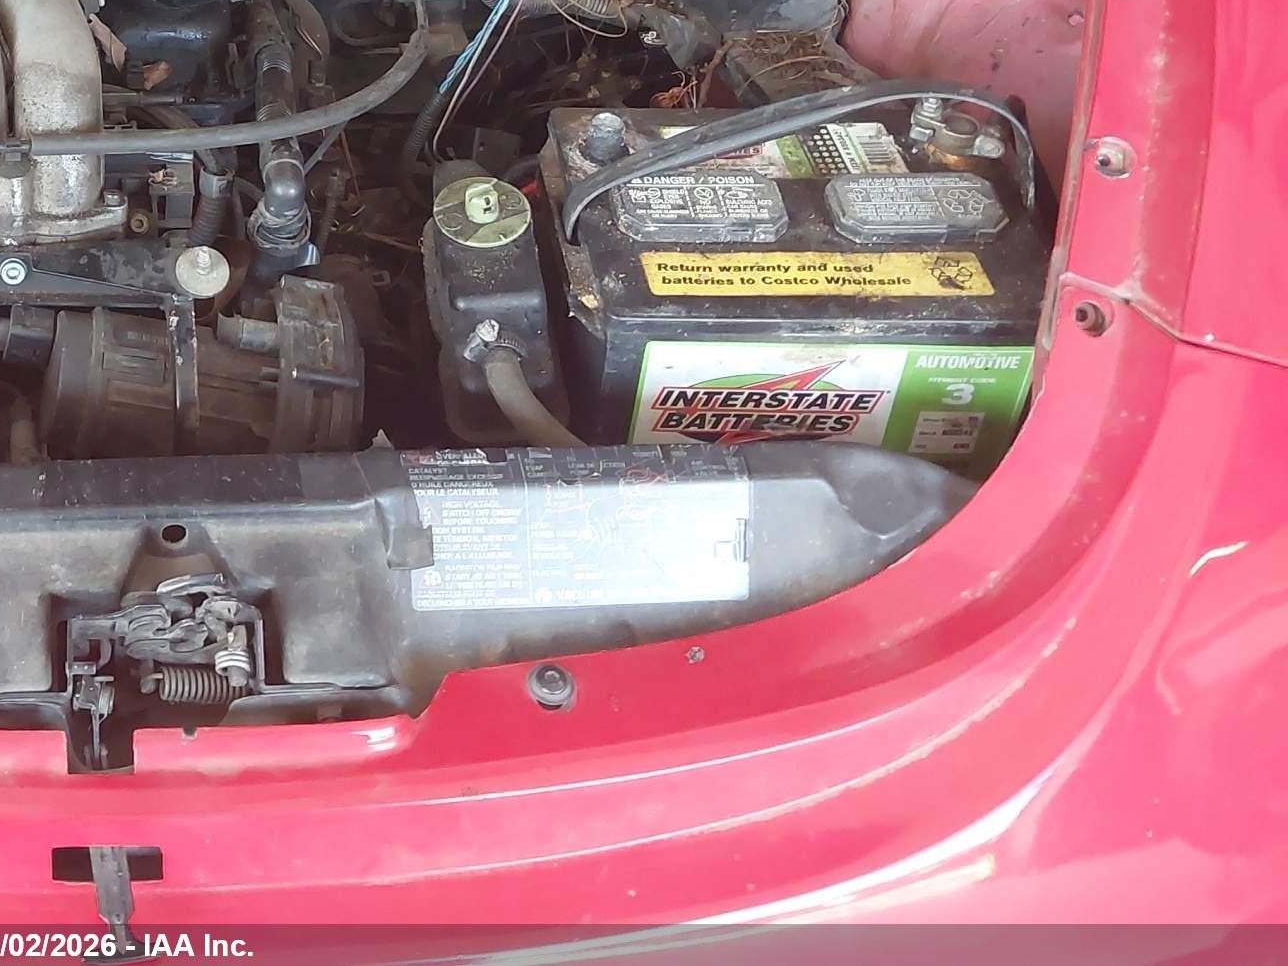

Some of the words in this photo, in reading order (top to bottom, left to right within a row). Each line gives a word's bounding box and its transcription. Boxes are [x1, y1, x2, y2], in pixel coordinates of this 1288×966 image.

[657, 262, 712, 273] Return
[718, 263, 791, 274] warranty
[797, 262, 828, 273] and
[833, 263, 874, 274] used
[661, 275, 735, 286] batteries
[740, 276, 757, 286] to
[761, 276, 819, 286] Costco
[824, 276, 912, 286] Wholesale
[915, 355, 1021, 369] AUTOMOTIVE
[658, 390, 876, 410] INTERSTATE
[941, 384, 975, 405] 3
[662, 414, 855, 433] BATTERIES
